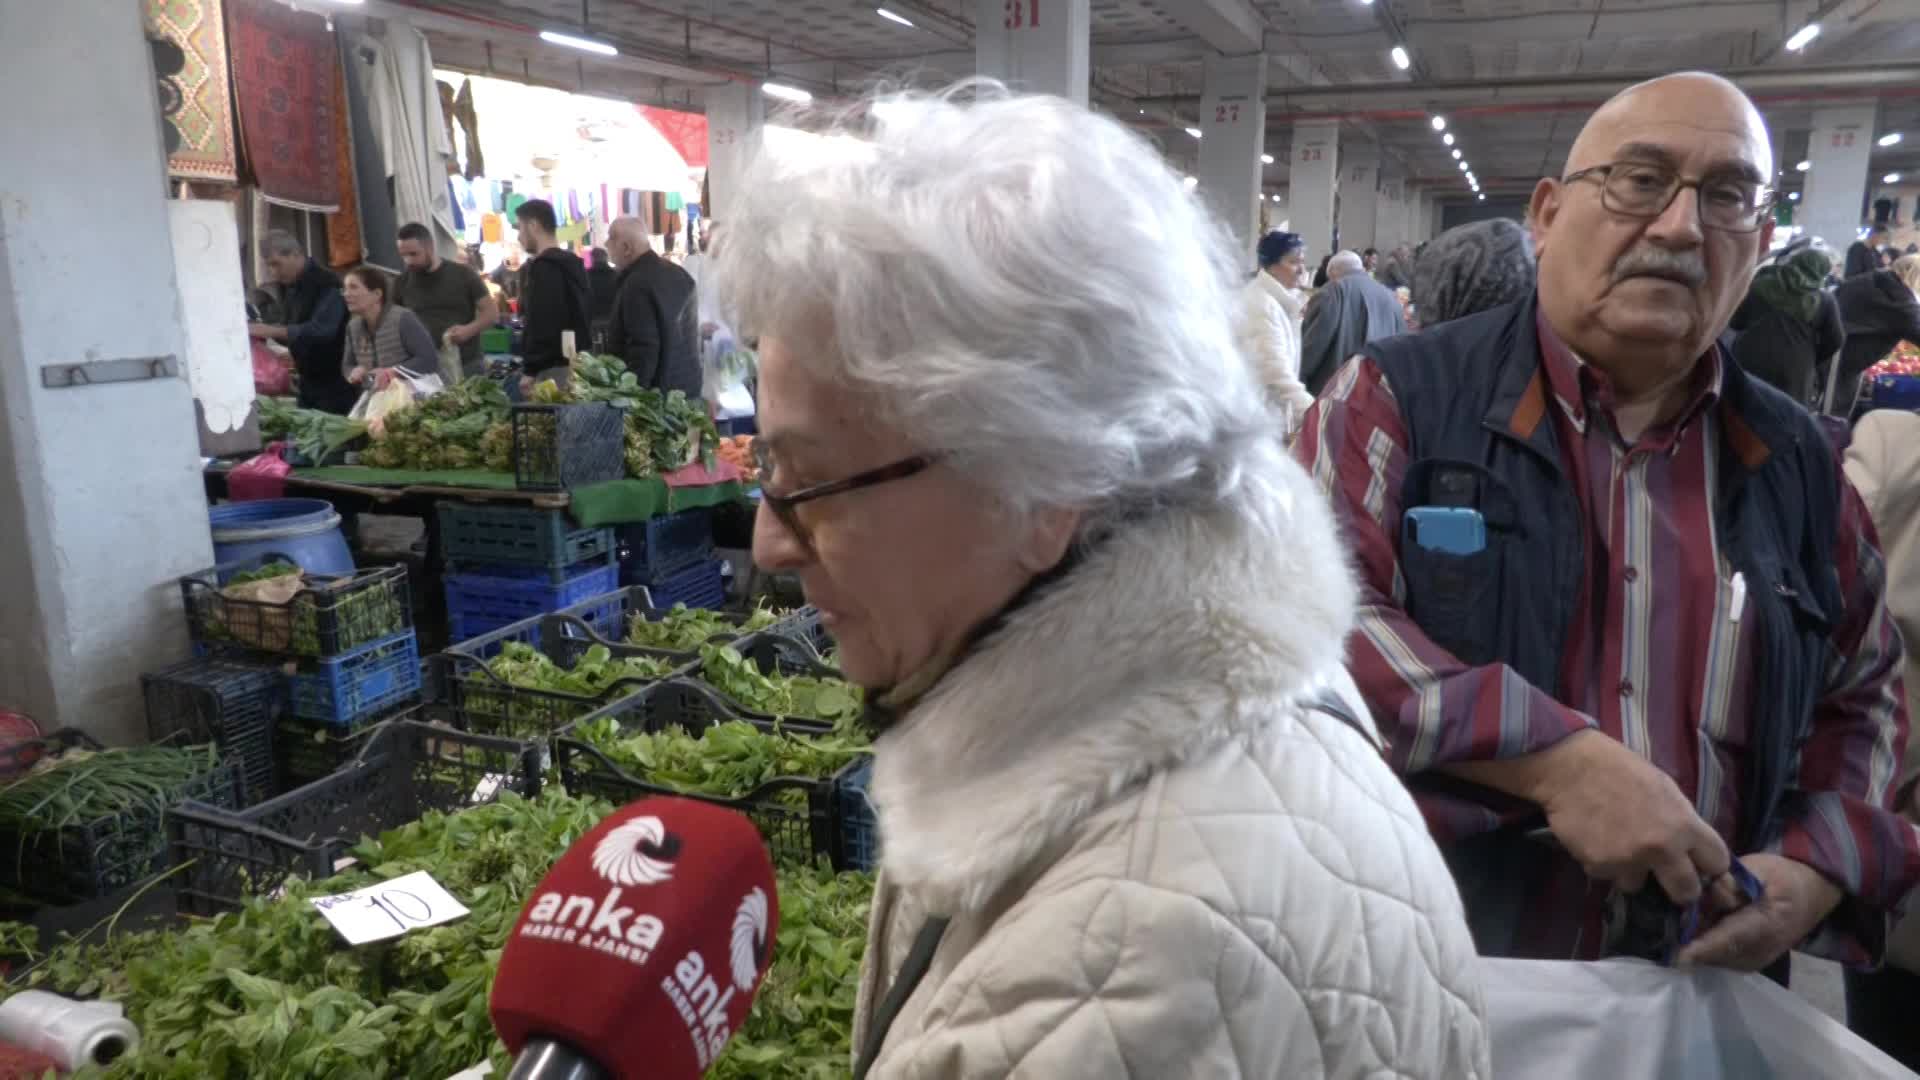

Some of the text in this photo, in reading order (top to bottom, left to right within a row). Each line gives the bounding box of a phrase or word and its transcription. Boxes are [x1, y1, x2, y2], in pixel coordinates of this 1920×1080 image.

[1004, 0, 1040, 30] 31
[1215, 104, 1240, 122] 27
[365, 889, 432, 929] 10
[528, 887, 665, 951] anka
[519, 923, 577, 943] HABER
[673, 950, 735, 1063] anka
